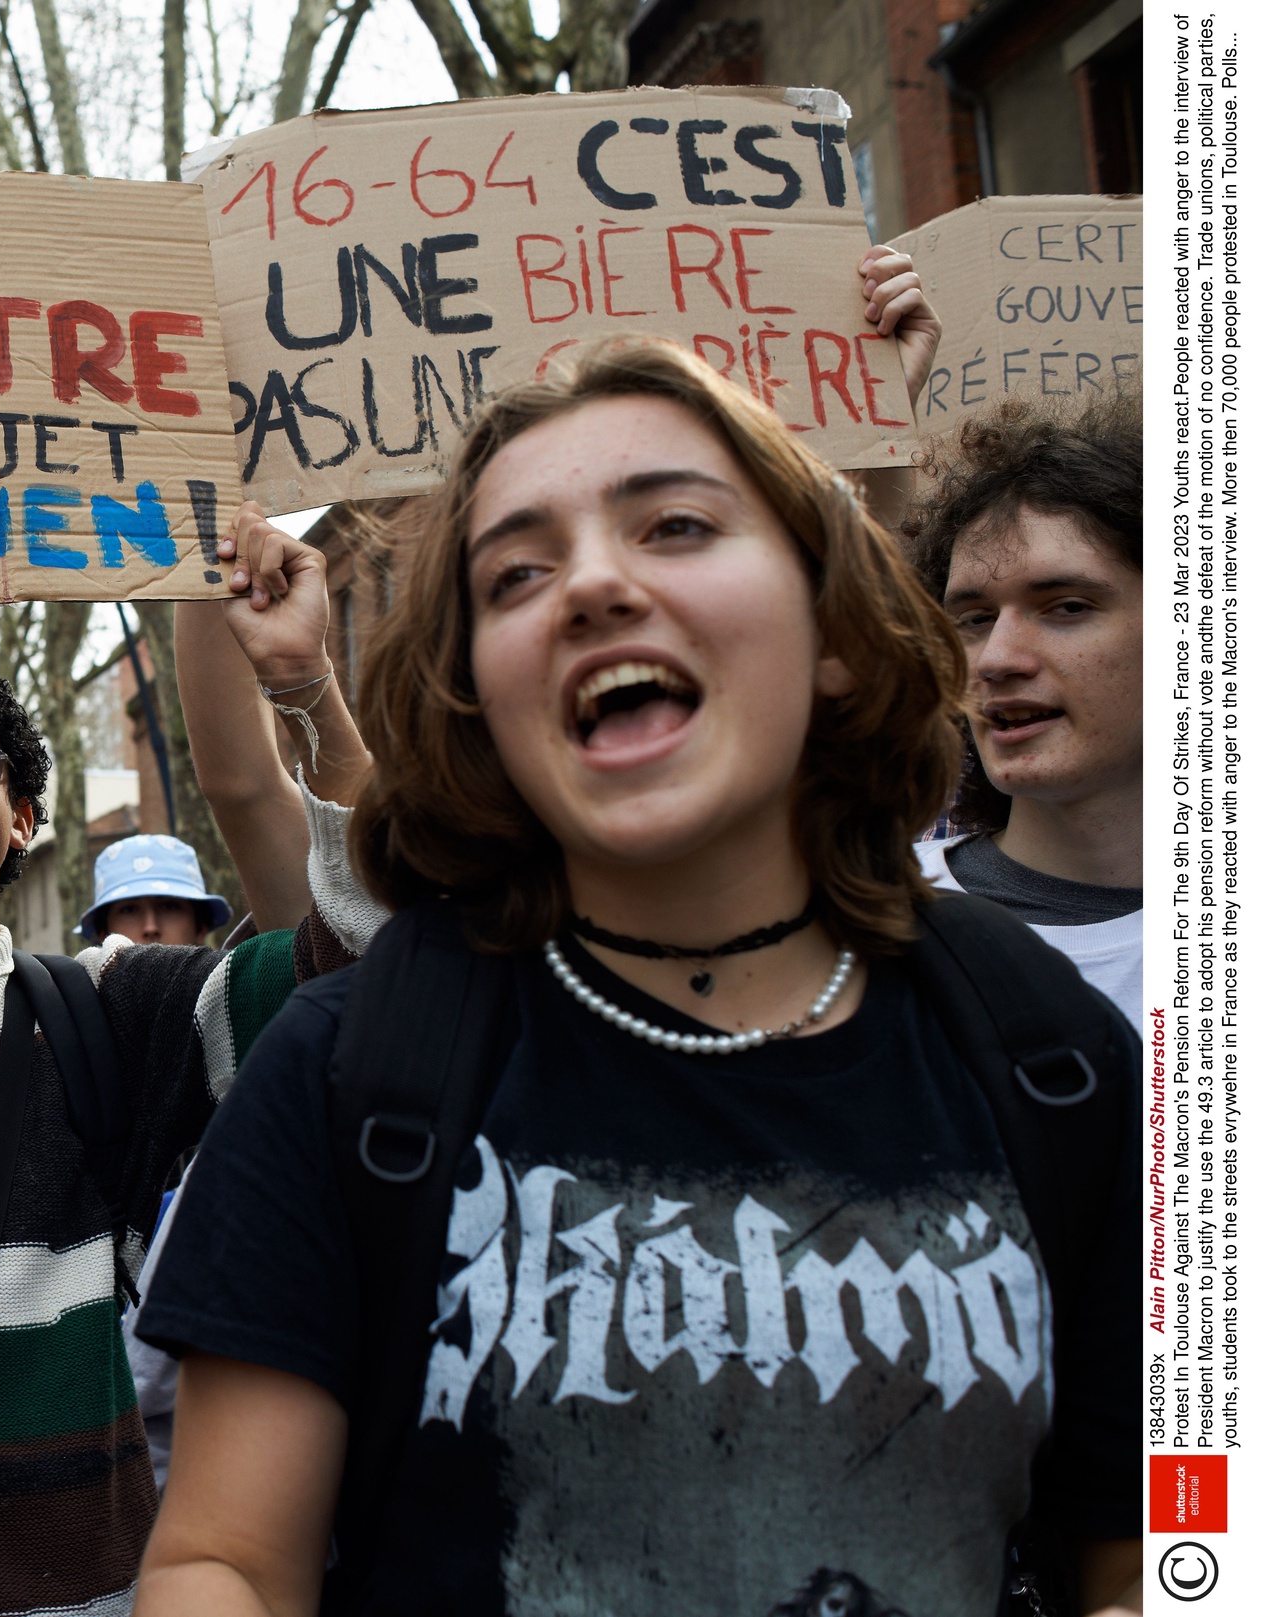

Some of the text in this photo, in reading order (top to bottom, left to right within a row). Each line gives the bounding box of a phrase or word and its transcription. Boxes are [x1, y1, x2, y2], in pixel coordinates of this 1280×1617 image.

[221, 117, 847, 241] 16-64 C'EST
[265, 233, 493, 350] UNE
[999, 223, 1137, 264] CERT
